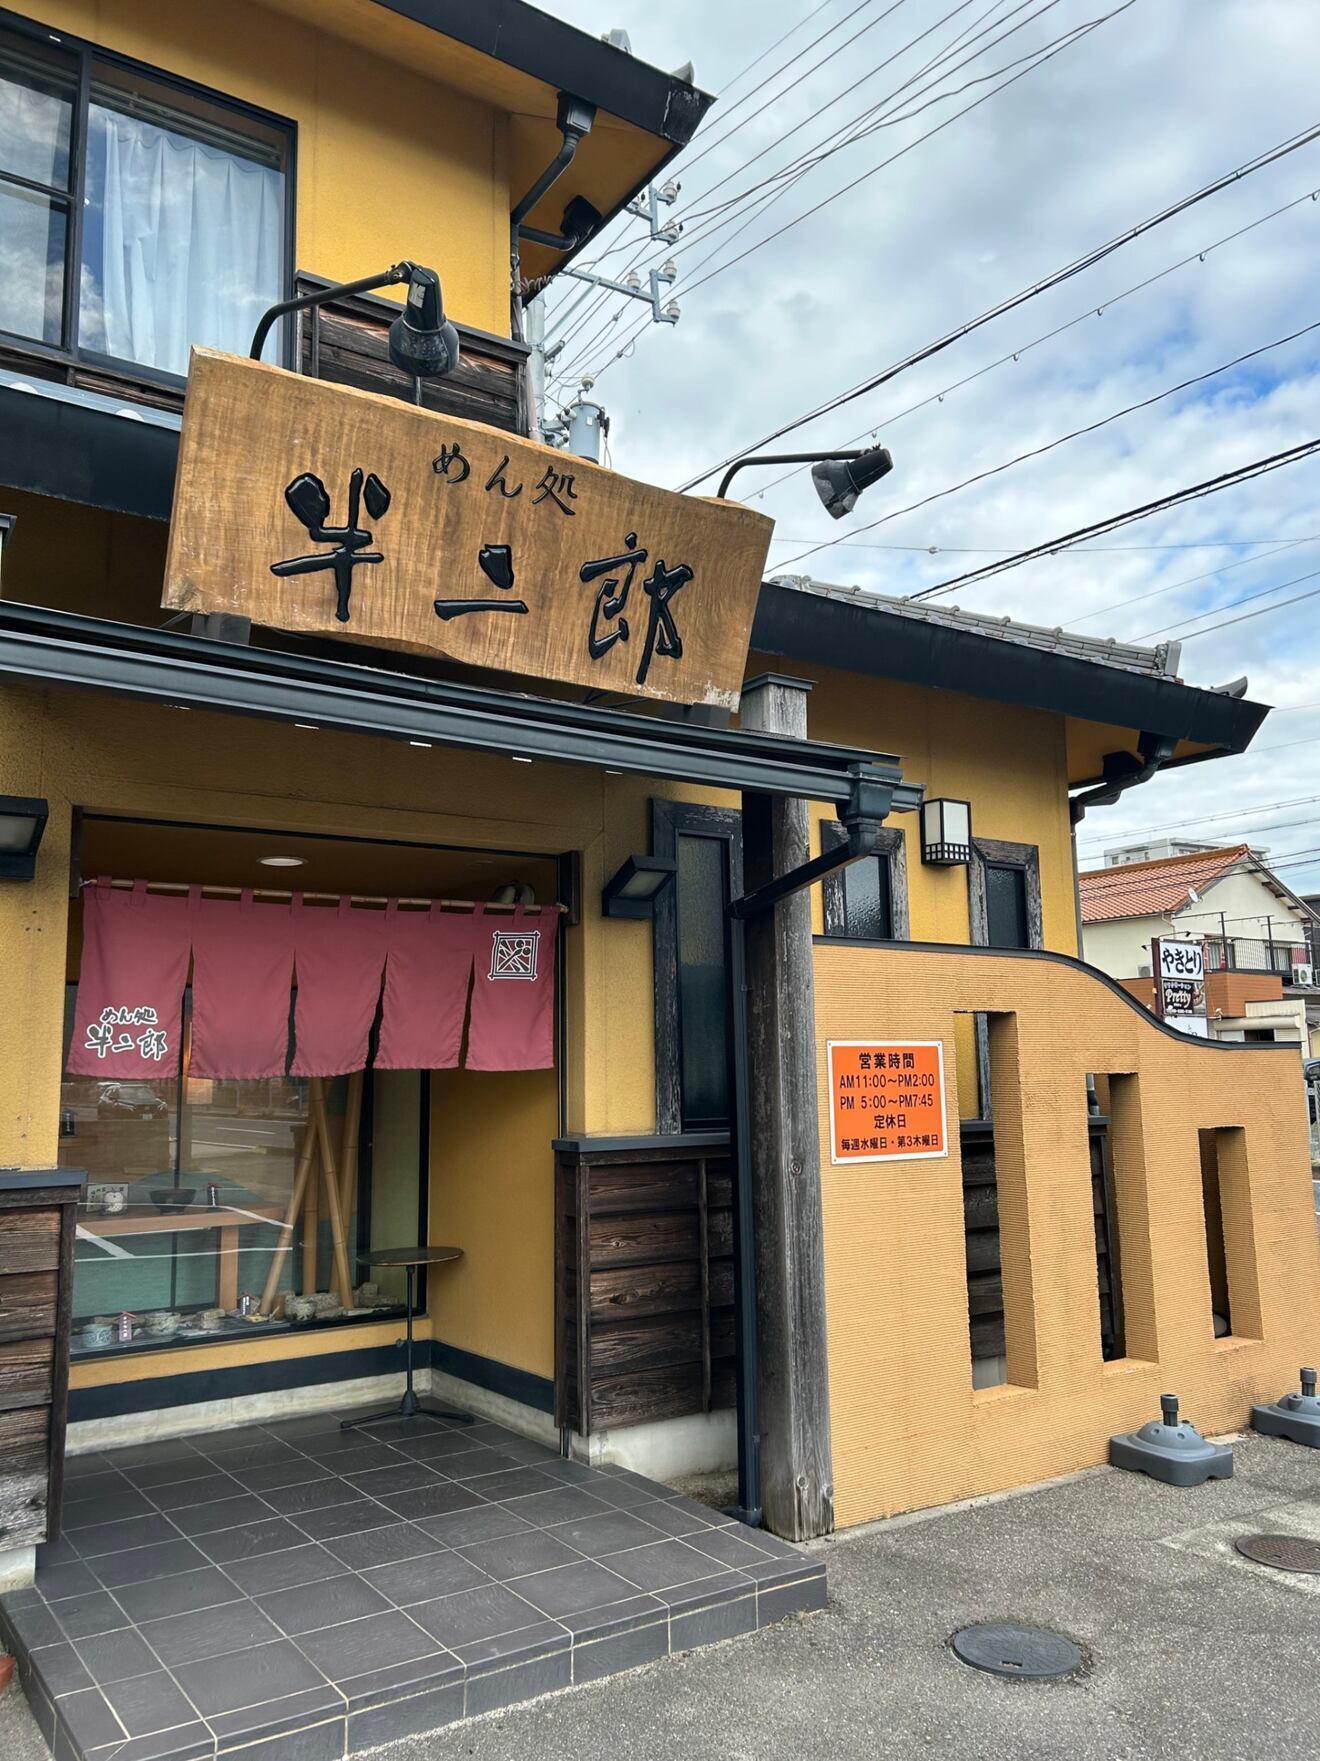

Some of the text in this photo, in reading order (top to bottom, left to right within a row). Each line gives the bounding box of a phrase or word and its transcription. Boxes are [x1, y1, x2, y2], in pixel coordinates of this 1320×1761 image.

[432, 443, 578, 516] めん処
[270, 467, 695, 685] 半二郎
[1162, 947, 1202, 975] やきとり
[1165, 988, 1191, 1008] Pretty
[100, 1006, 158, 1025] めん処
[84, 1024, 168, 1061] 半二郎
[858, 1052, 915, 1070] 営業時間
[873, 1113, 907, 1129] 定休日
